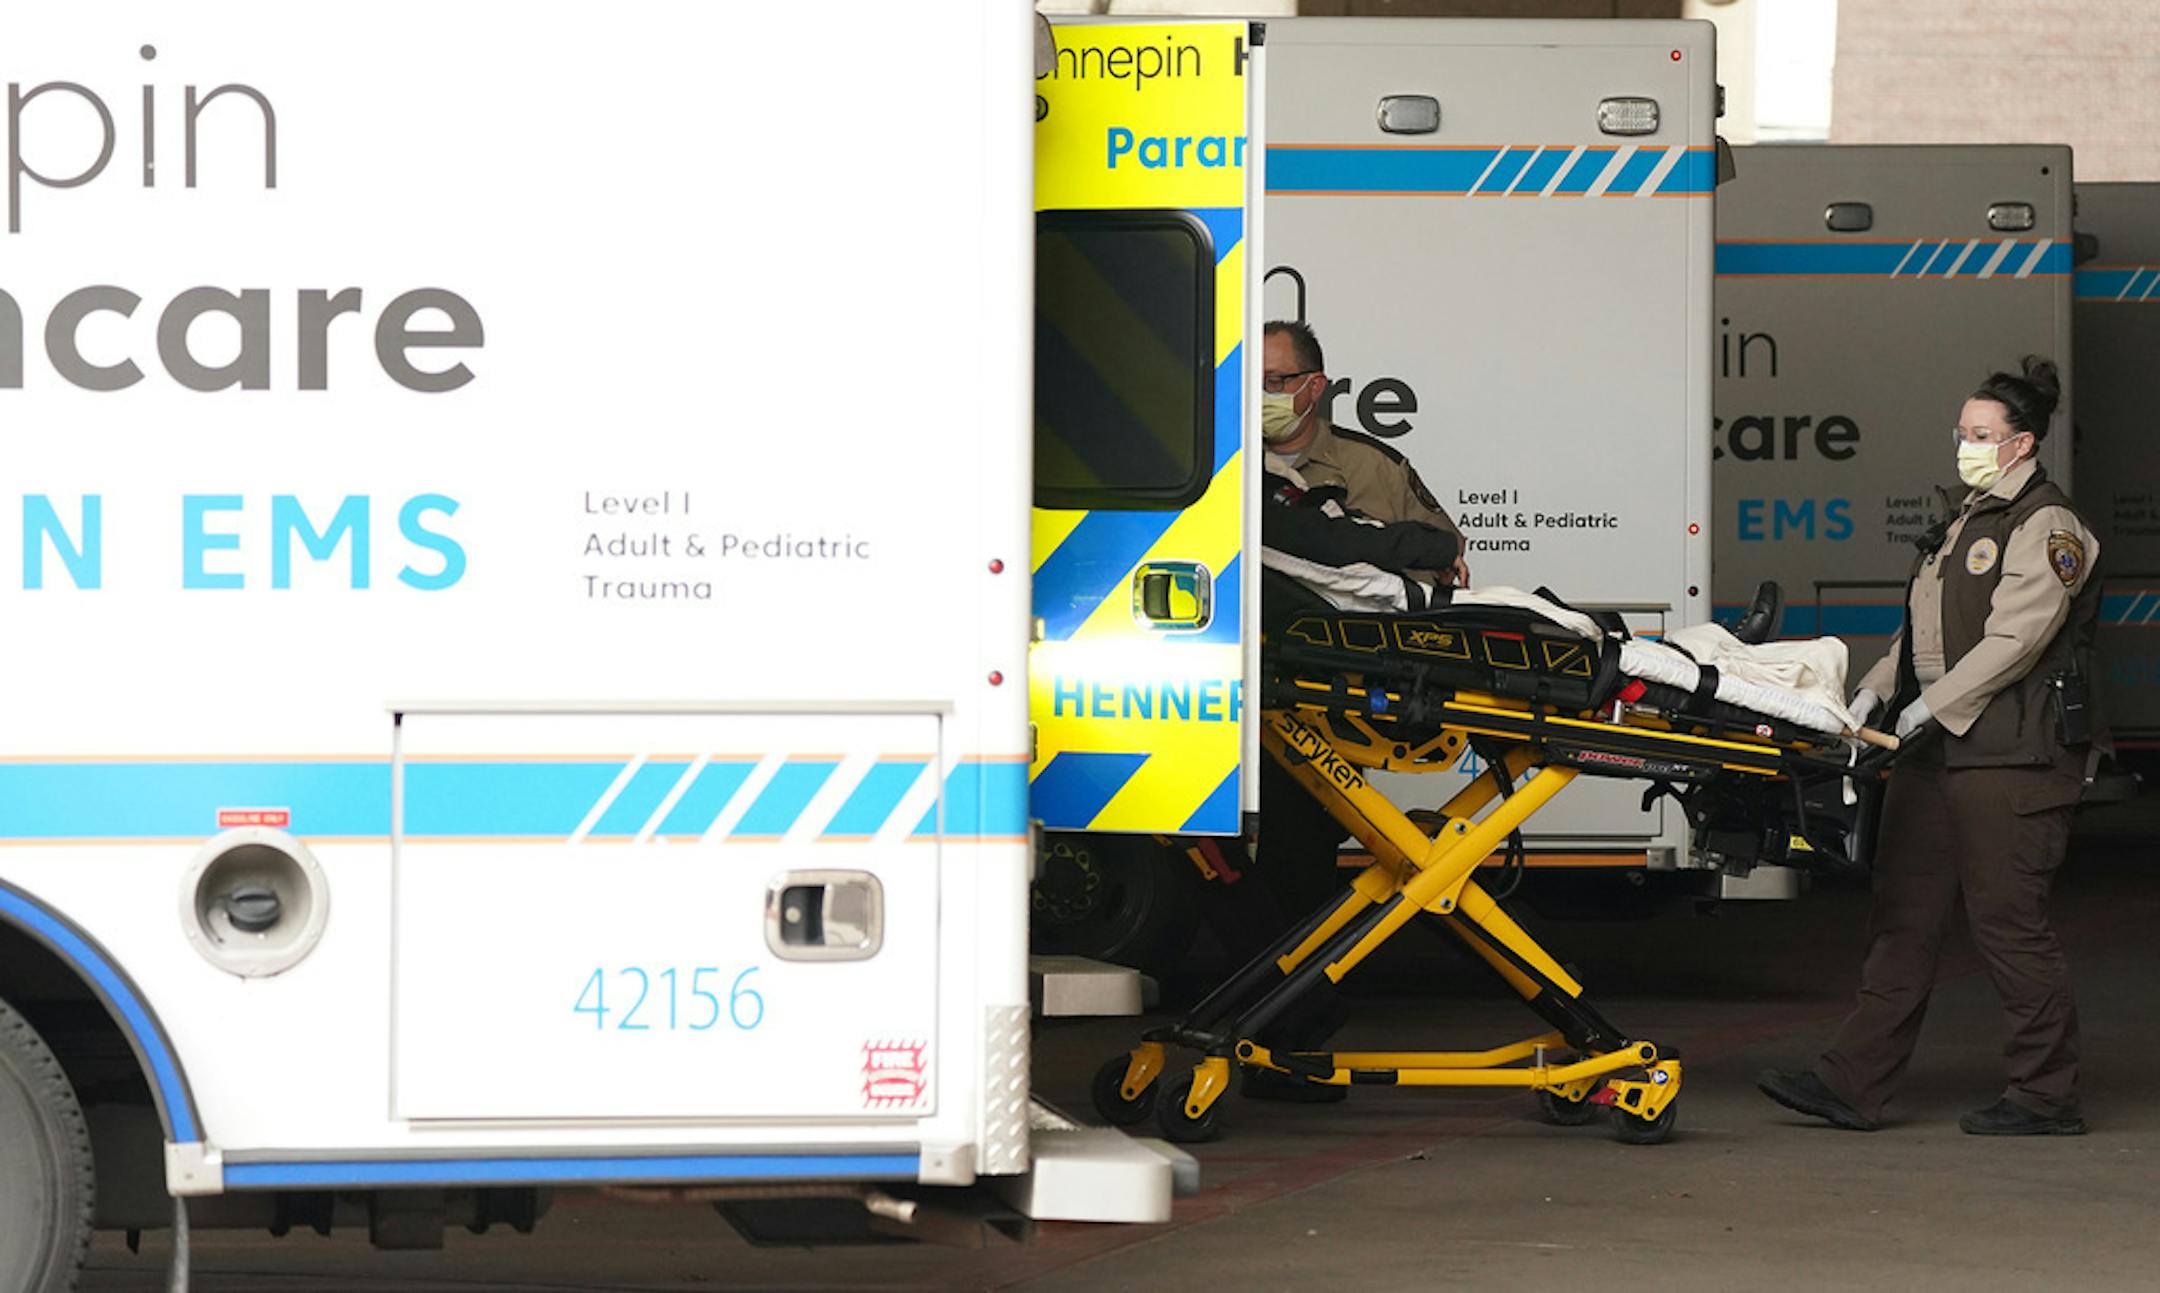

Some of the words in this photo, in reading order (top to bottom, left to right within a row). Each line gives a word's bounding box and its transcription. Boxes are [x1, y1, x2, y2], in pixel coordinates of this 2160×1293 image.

[1036, 35, 1201, 91] nnepin
[8, 44, 277, 234] pin
[1722, 318, 1778, 377] in
[1713, 416, 1861, 461] are
[584, 490, 670, 515] Level
[1458, 489, 1507, 505] Level
[1738, 496, 1854, 541] EMS
[22, 494, 102, 591] N
[182, 492, 468, 592] EMS
[1457, 512, 1509, 528] Adult
[1514, 513, 1528, 528] &
[1534, 512, 1619, 528] Pediatric
[583, 532, 671, 557] Adult
[685, 533, 705, 557] &
[722, 533, 870, 559] Pediatric
[1464, 538, 1531, 551] rauma
[583, 575, 712, 600] Trauma
[1278, 712, 1364, 790] stryker
[572, 965, 765, 1031] 42156
